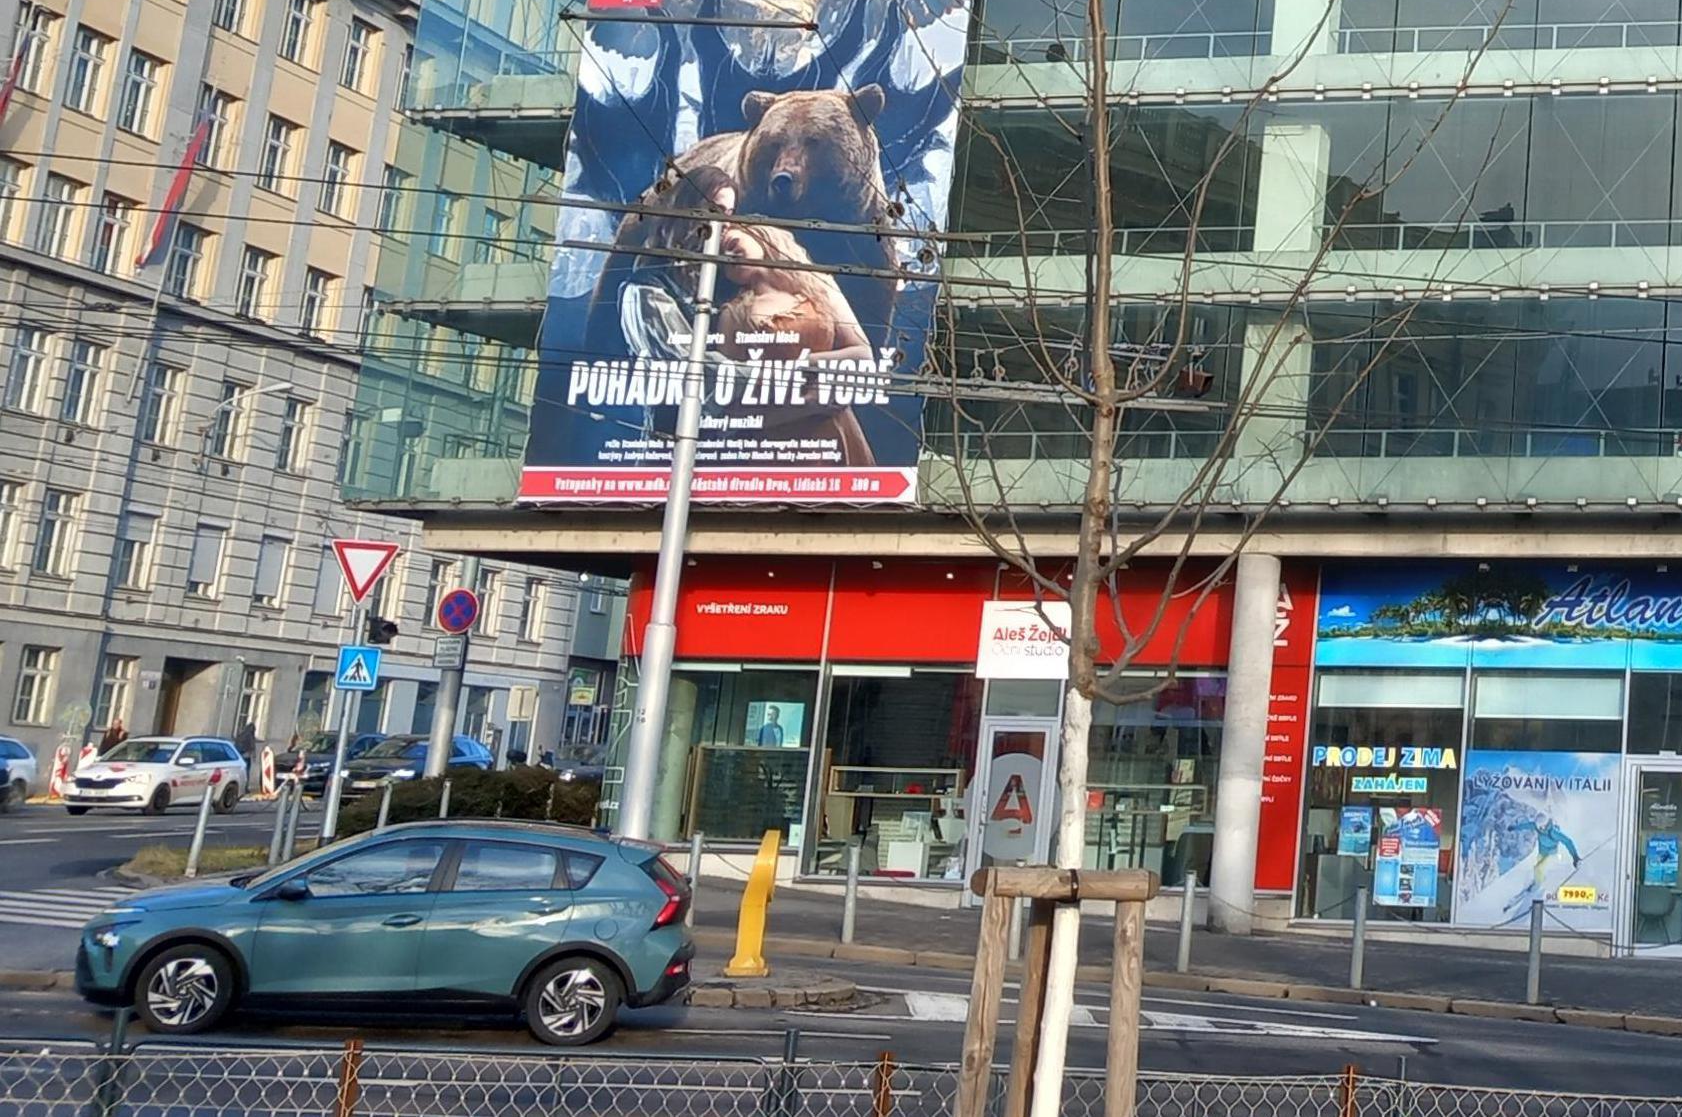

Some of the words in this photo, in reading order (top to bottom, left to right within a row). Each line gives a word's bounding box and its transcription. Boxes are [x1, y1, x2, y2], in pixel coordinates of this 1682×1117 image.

[714, 360, 735, 406] O
[741, 348, 810, 406] ŽIVÉ
[752, 604, 789, 615] ZRAKU
[993, 626, 1026, 641] Aleš
[1024, 643, 1064, 657] studio
[1312, 746, 1396, 767] PRODEJ
[1399, 746, 1457, 769] ZIMA
[1351, 772, 1428, 793] ZAHÁJEN
[1473, 771, 1549, 790] LYŽOVÁNÍ
[1555, 779, 1564, 790] V
[1569, 775, 1611, 792] ITÁLII
